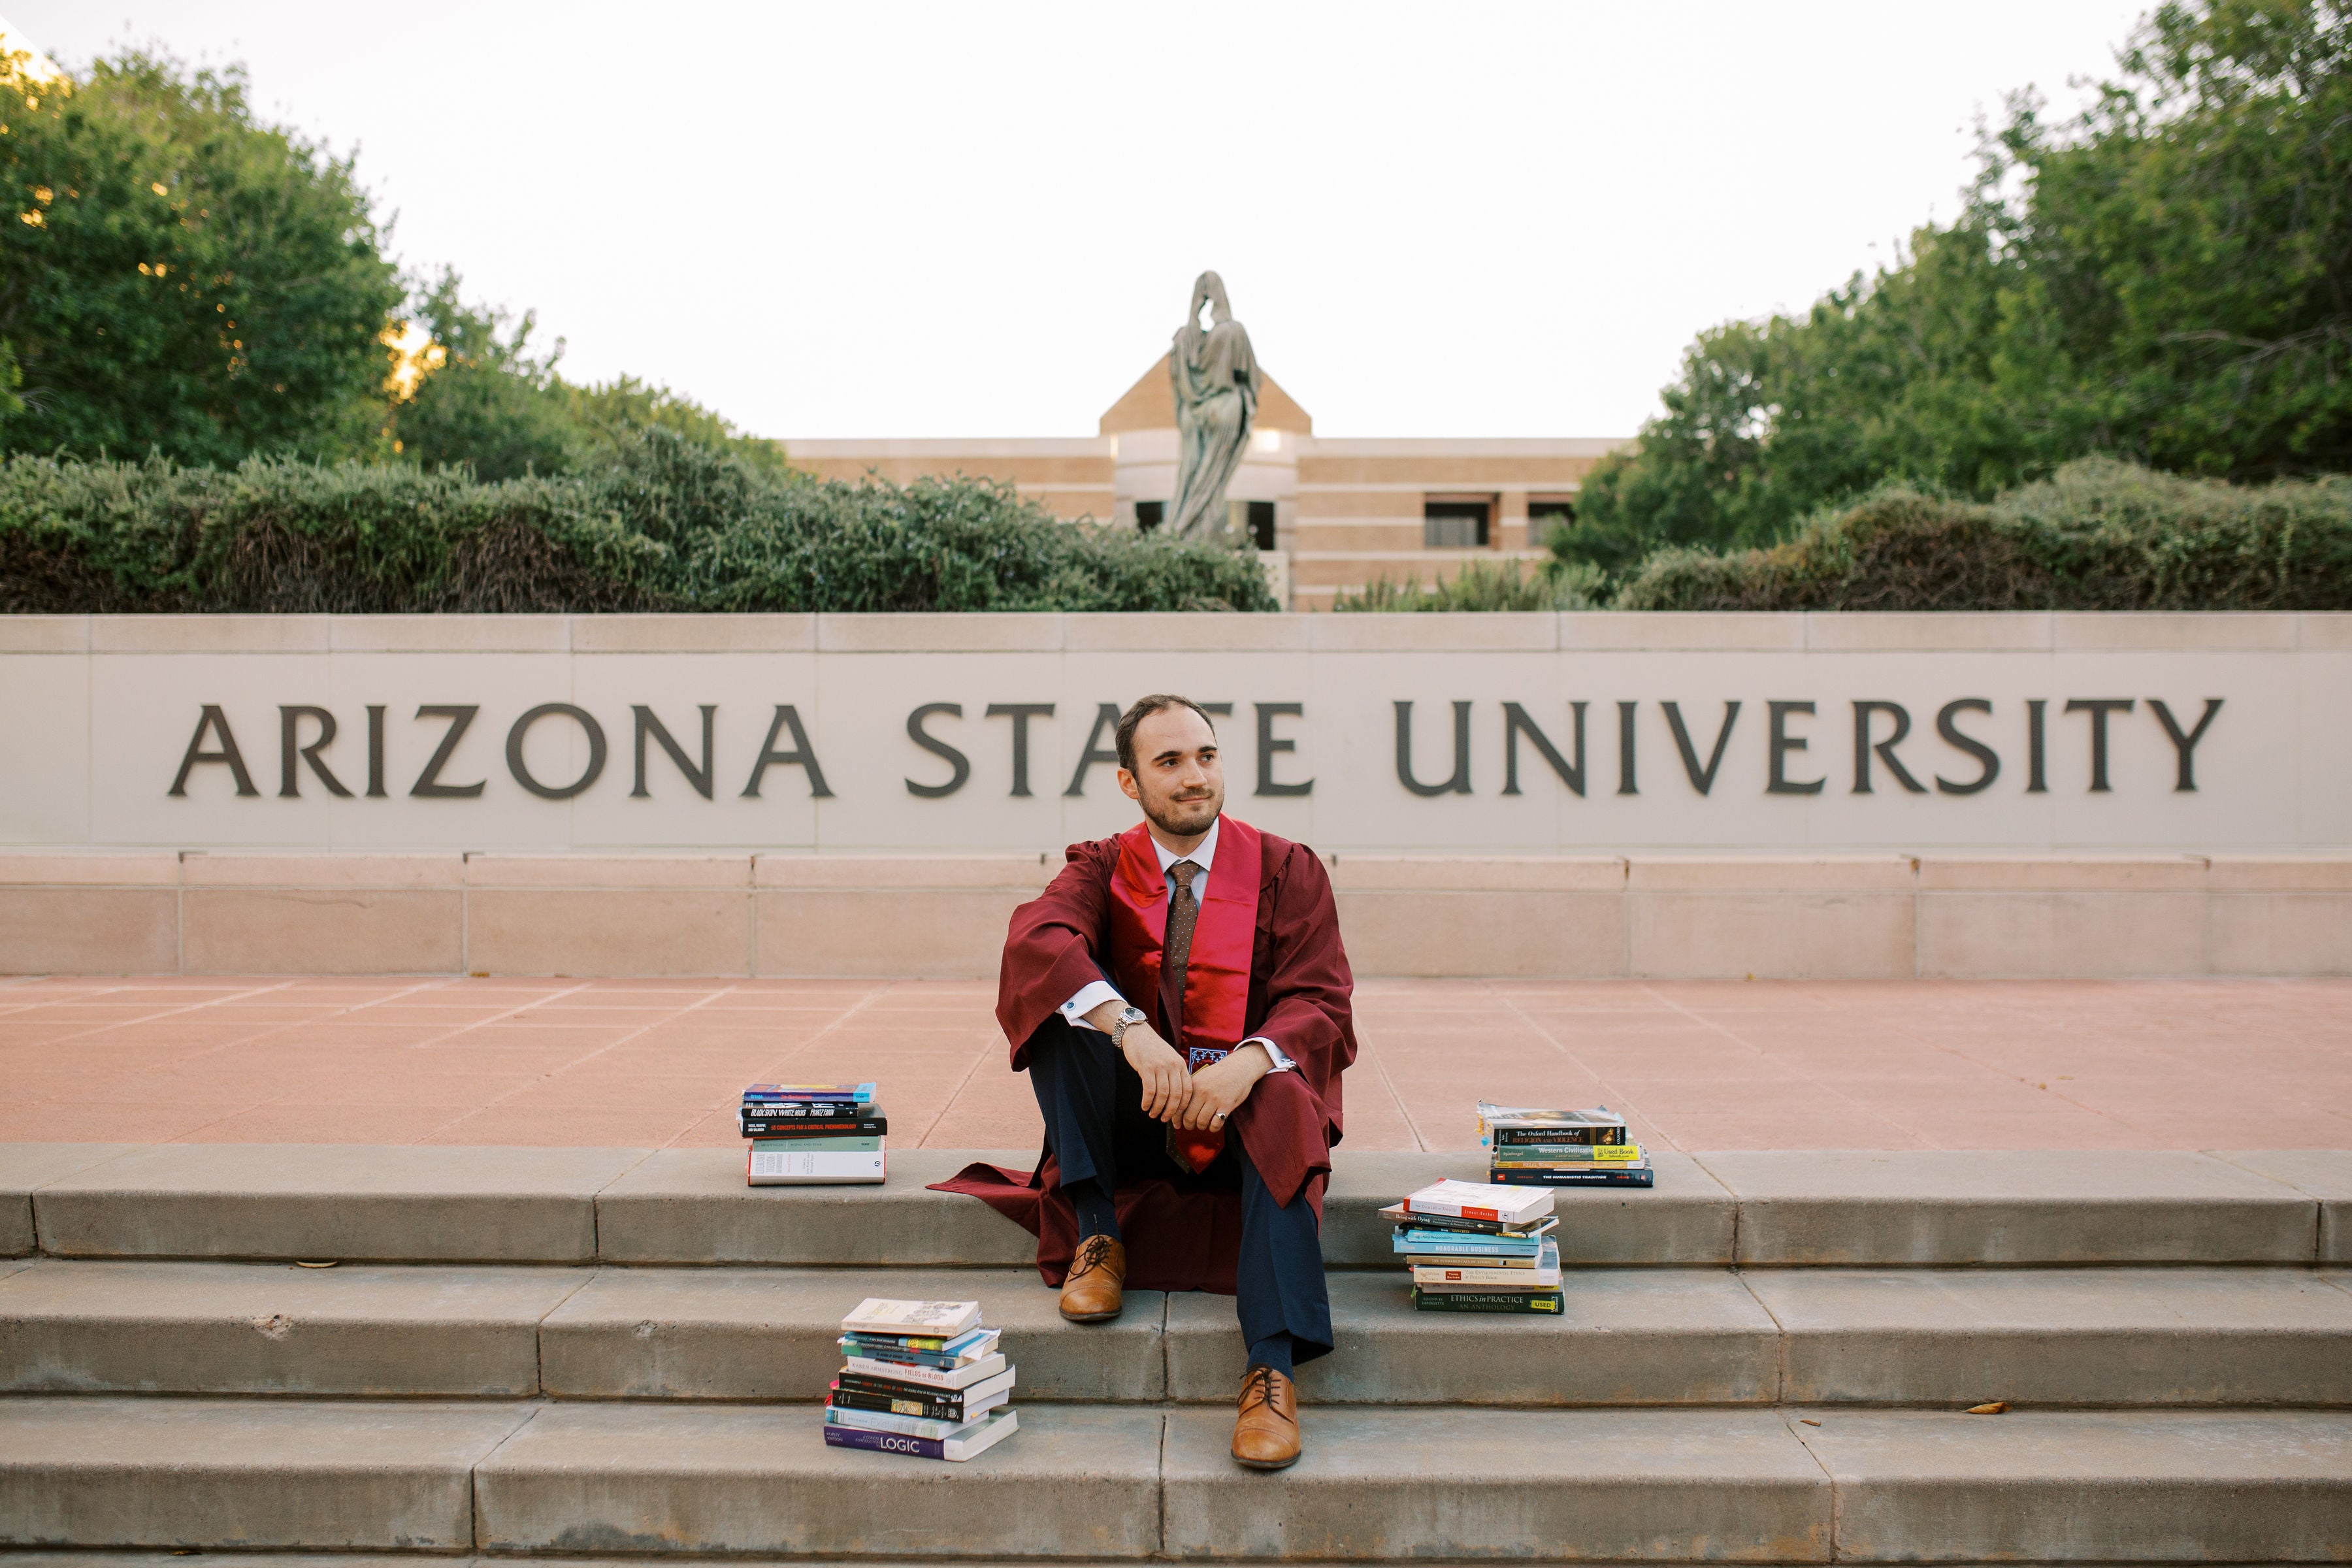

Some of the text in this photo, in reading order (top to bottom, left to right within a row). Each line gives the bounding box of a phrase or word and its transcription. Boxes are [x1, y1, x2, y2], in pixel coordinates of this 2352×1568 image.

[167, 703, 836, 800] ARIZONA
[1392, 697, 2225, 798] UNIVERSITY
[870, 1366, 902, 1376] ARMSTRONG
[904, 1369, 921, 1378] FIELDS
[928, 1373, 944, 1381] BLOOD
[880, 1437, 920, 1453] LOGIC
